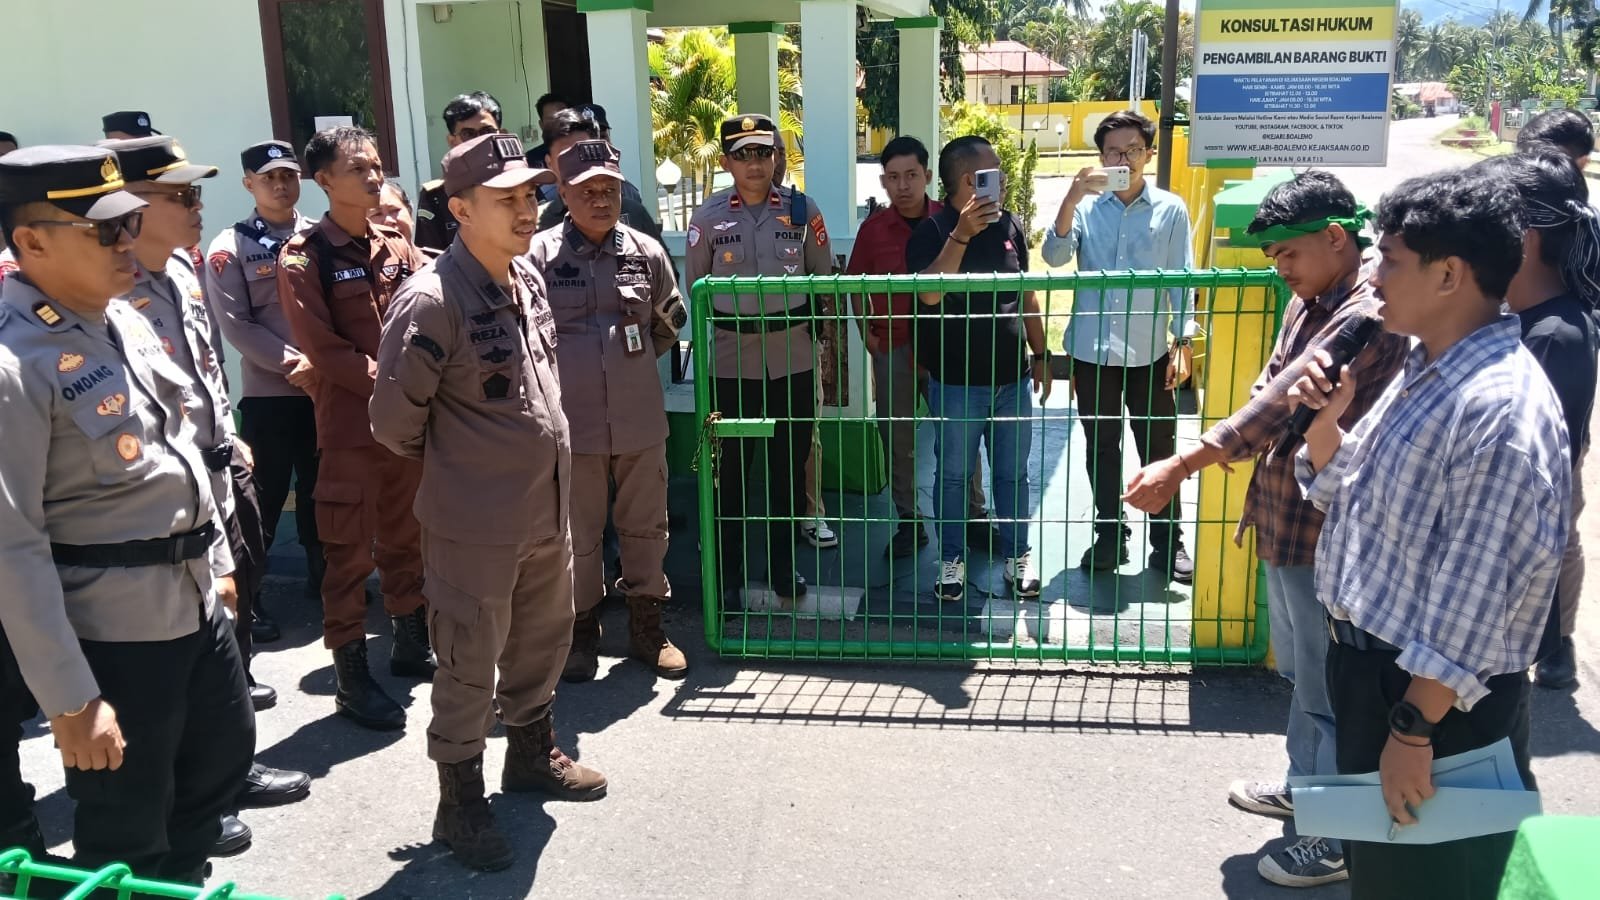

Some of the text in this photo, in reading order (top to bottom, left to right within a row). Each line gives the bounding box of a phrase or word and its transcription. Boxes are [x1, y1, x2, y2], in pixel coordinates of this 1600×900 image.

[1220, 16, 1373, 33] KONSULTASI HUKUM
[1203, 50, 1387, 65] PENGAMBILAN BARANG BUKTI
[470, 327, 508, 343] REZA
[62, 365, 114, 401] ONDANG
